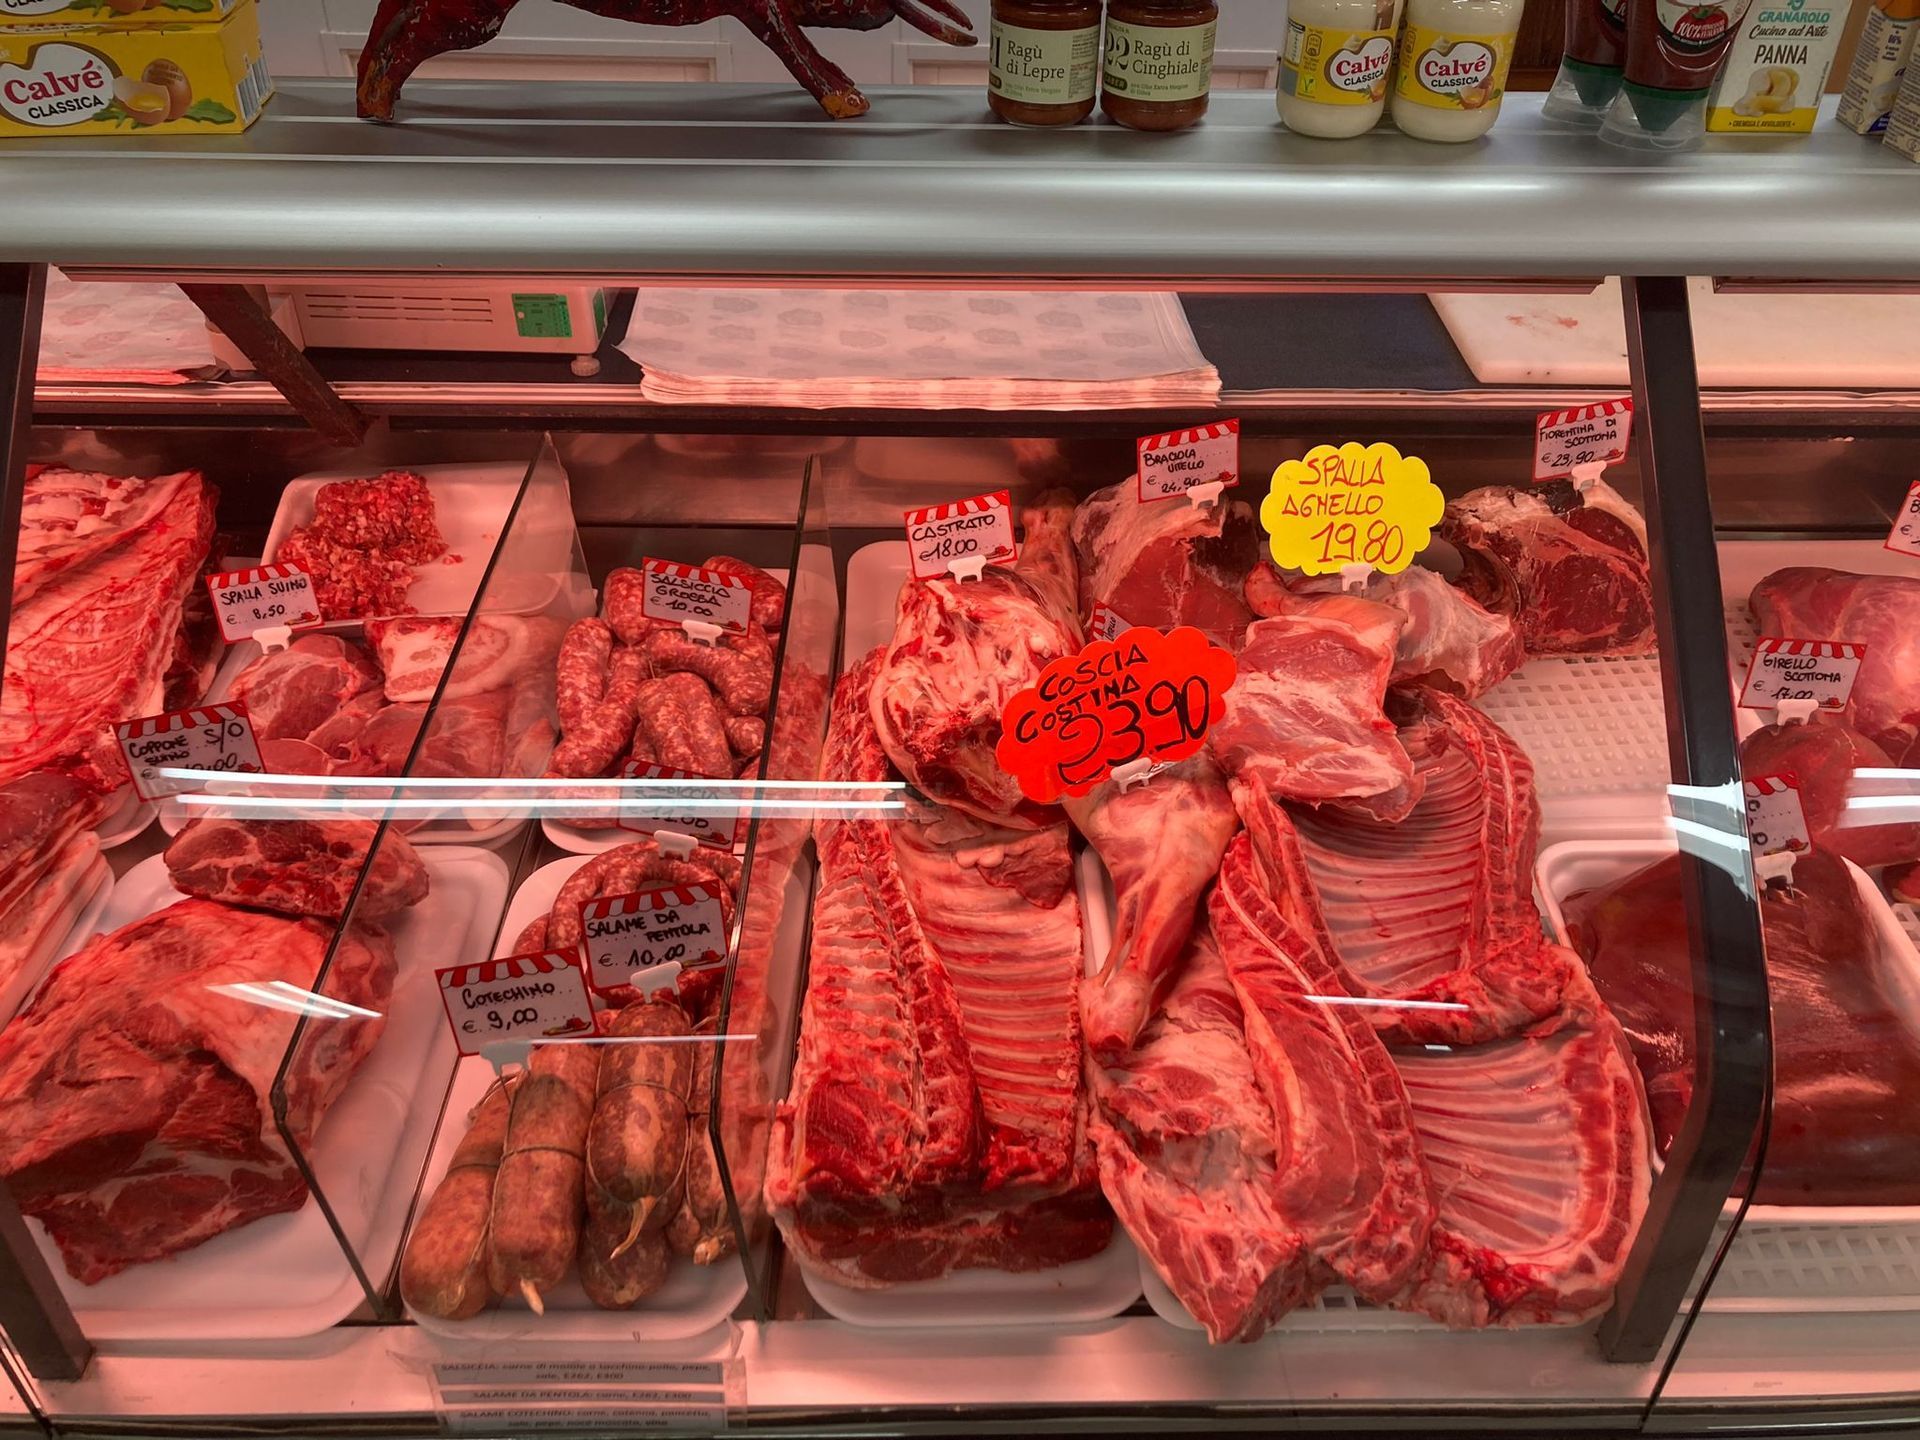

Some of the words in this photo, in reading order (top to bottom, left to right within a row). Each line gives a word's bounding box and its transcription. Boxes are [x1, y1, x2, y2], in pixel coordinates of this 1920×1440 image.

[1758, 11, 1831, 23] GRANAROLO
[1676, 22, 1701, 38] 100%
[1749, 25, 1788, 40] Cucina
[1788, 25, 1805, 36] ad
[1804, 26, 1830, 37] Arte
[1007, 40, 1042, 62] Ragù
[1134, 40, 1171, 60] Ragù
[1176, 41, 1190, 56] di
[1336, 46, 1391, 76] Calvé
[1754, 44, 1808, 64] PANNA
[1006, 59, 1018, 75] di
[1023, 63, 1065, 82] Lepre
[1132, 59, 1199, 79] Cinghiale
[1424, 53, 1487, 76] Calvé
[4, 60, 105, 104] Calvé
[1344, 69, 1384, 86] CLASSICA
[1431, 76, 1480, 87] CLASSICA
[28, 95, 104, 119] CLASSICA
[1540, 423, 1595, 443] FIORENTINA
[1605, 418, 1617, 427] DI
[1564, 430, 1617, 448] SCOTTONA
[1143, 448, 1196, 467] BRACIOLA
[1299, 454, 1385, 488] SPALLA
[1282, 491, 1384, 518] AGNELLO
[912, 514, 996, 541] CASTRATO
[1310, 519, 1404, 564] 19.80
[220, 586, 262, 606] SPALLA
[268, 577, 308, 595] SUINO
[650, 574, 731, 598] SALSICCIA
[655, 585, 722, 608] GROSSA
[253, 604, 285, 620] 8,50
[1039, 643, 1149, 702] COSCIA
[1763, 653, 1818, 670] GIRELLO
[1783, 670, 1841, 683] SCOTTONA
[1015, 674, 1142, 743] COSTINA
[129, 735, 189, 759] COPPONE
[144, 750, 190, 767] SUINO
[586, 916, 647, 938] SALAME
[654, 910, 680, 924] DA
[644, 923, 711, 943] PENTOLA
[627, 943, 686, 967] 10,00
[462, 983, 555, 1010] COTECHINO
[487, 1007, 538, 1031] 9,00
